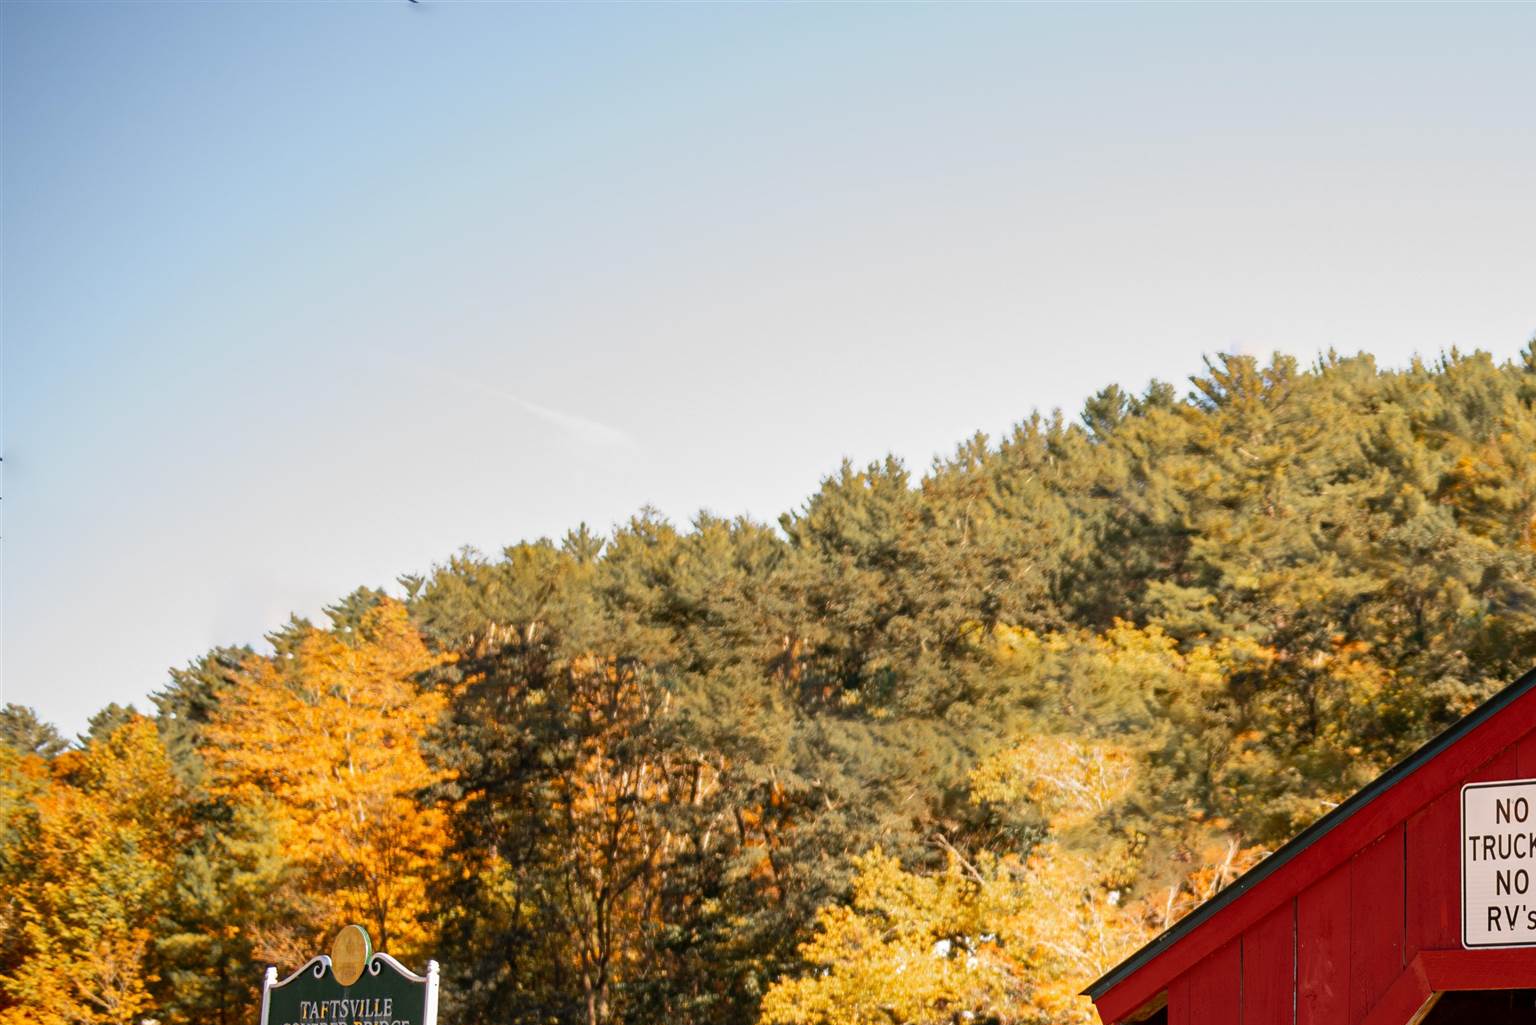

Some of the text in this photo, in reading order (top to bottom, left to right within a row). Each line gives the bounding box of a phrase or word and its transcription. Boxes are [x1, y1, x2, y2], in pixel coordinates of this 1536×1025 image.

[1496, 797, 1529, 825] NO
[1496, 868, 1530, 896] NO
[301, 998, 393, 1019] TAFTSVILLE
